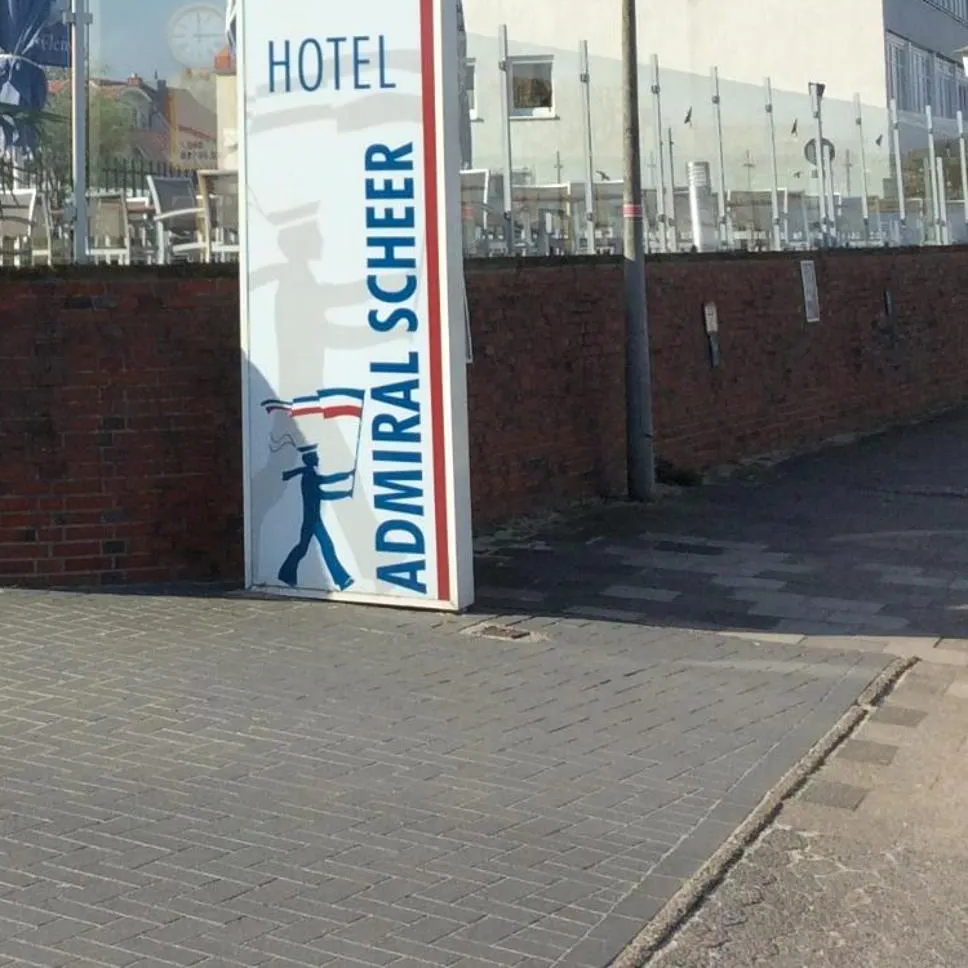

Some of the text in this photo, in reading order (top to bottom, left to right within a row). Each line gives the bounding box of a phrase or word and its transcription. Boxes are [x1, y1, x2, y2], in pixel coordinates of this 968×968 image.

[268, 35, 397, 93] HOTEL
[364, 141, 427, 594] ADMIRAL SCHEER
